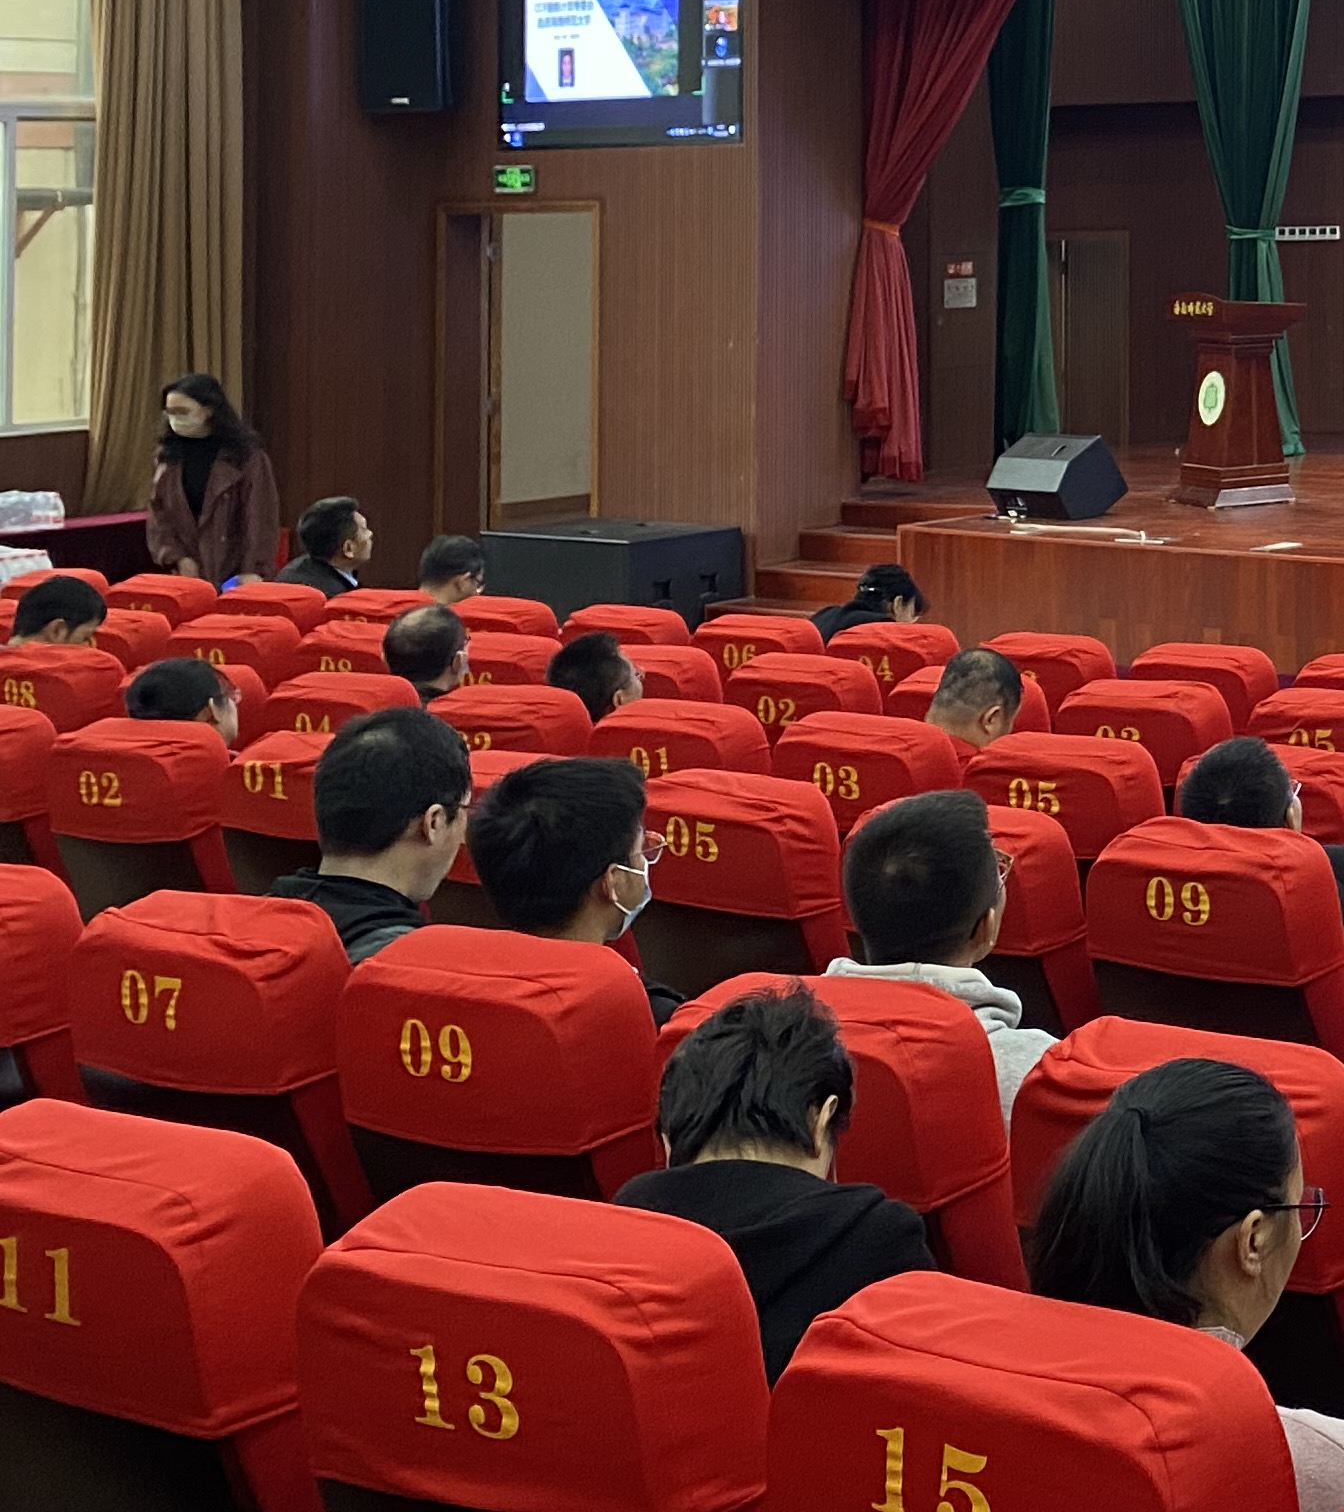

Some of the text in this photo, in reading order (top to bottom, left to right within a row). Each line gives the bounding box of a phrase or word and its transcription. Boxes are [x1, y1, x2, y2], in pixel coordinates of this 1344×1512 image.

[4, 678, 37, 709] 08
[757, 695, 797, 726] 02
[243, 759, 289, 800] 01
[629, 746, 673, 777] 01
[812, 761, 861, 800] 03
[79, 770, 123, 807] 02
[1008, 776, 1061, 816] 05
[665, 815, 719, 863] 05
[1146, 876, 1211, 926] 09
[121, 969, 182, 1031] 07
[399, 1018, 473, 1083] 09
[0, 1235, 82, 1326] 11
[408, 1343, 521, 1440] 13
[869, 1425, 991, 1512] 15
